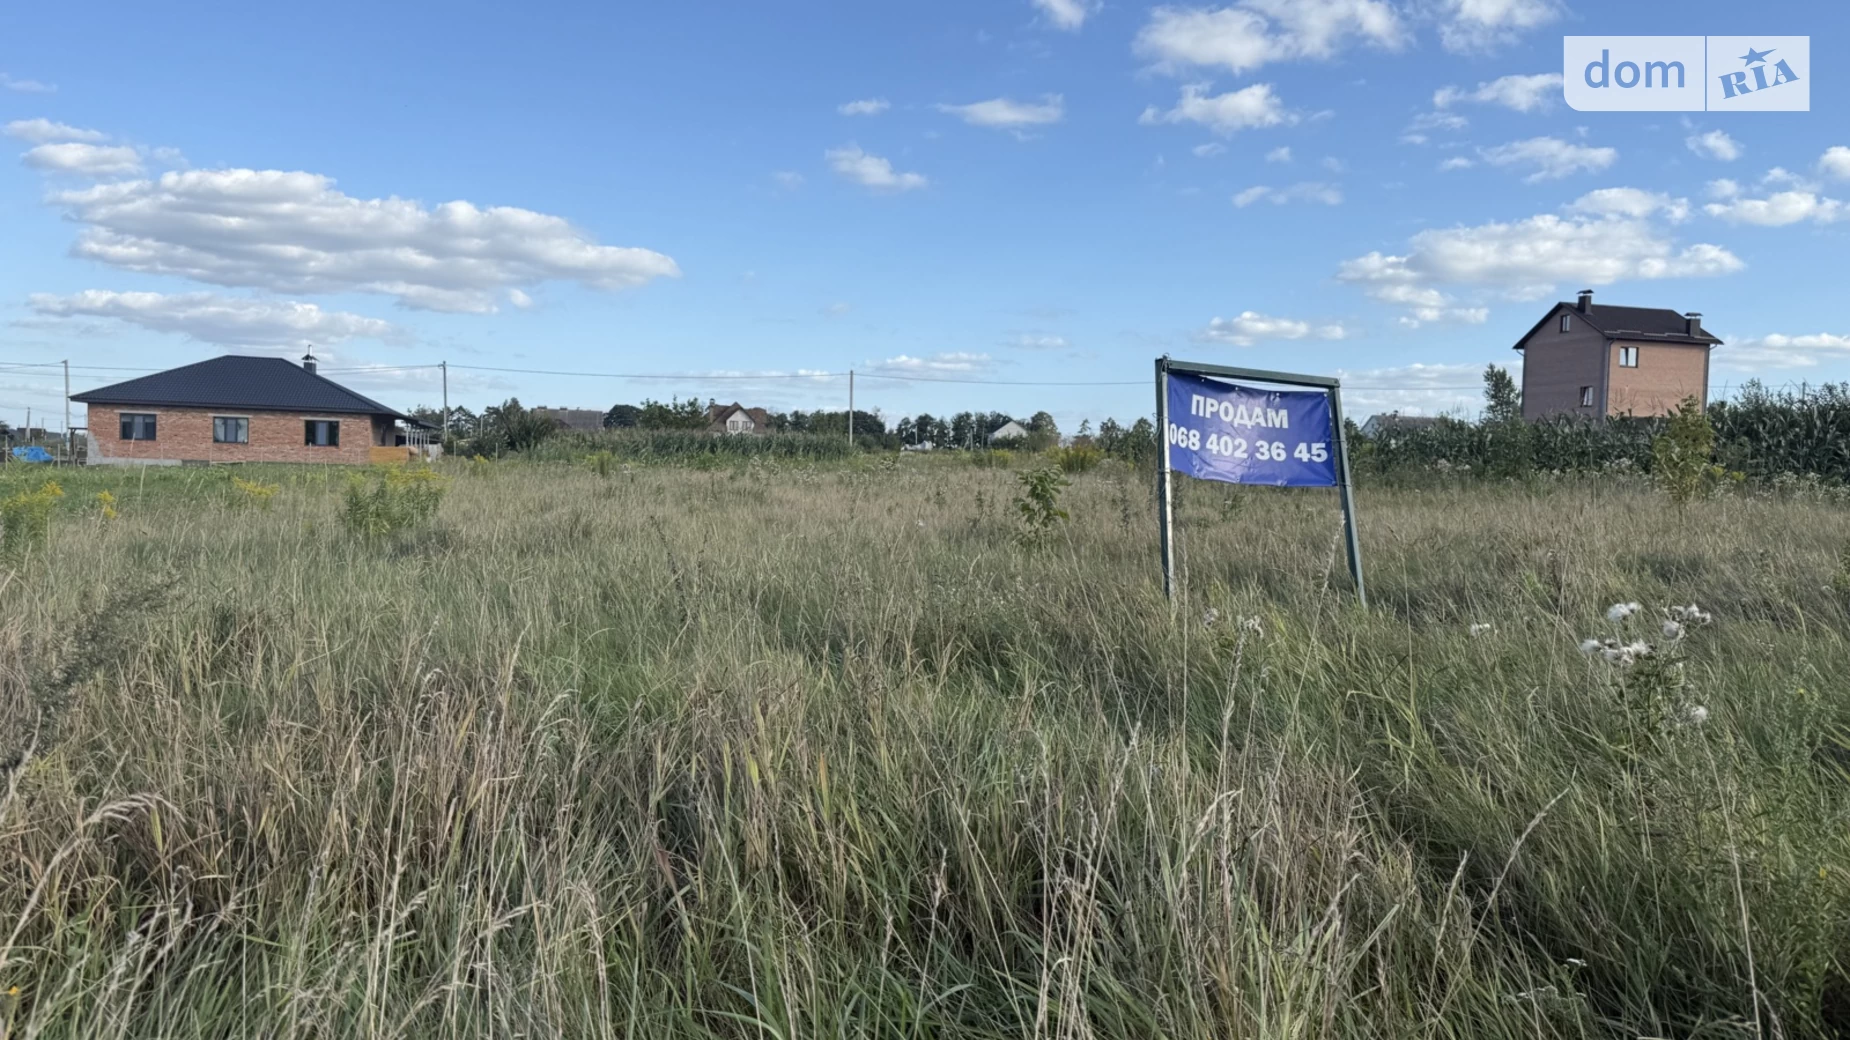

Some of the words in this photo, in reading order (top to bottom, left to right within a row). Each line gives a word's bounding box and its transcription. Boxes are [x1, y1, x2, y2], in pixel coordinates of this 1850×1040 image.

[1191, 394, 1289, 429] ПРОДАМ
[1169, 423, 1200, 451] 068
[1206, 433, 1248, 459] 402
[1255, 440, 1287, 462] 36
[1293, 442, 1328, 463] 45
